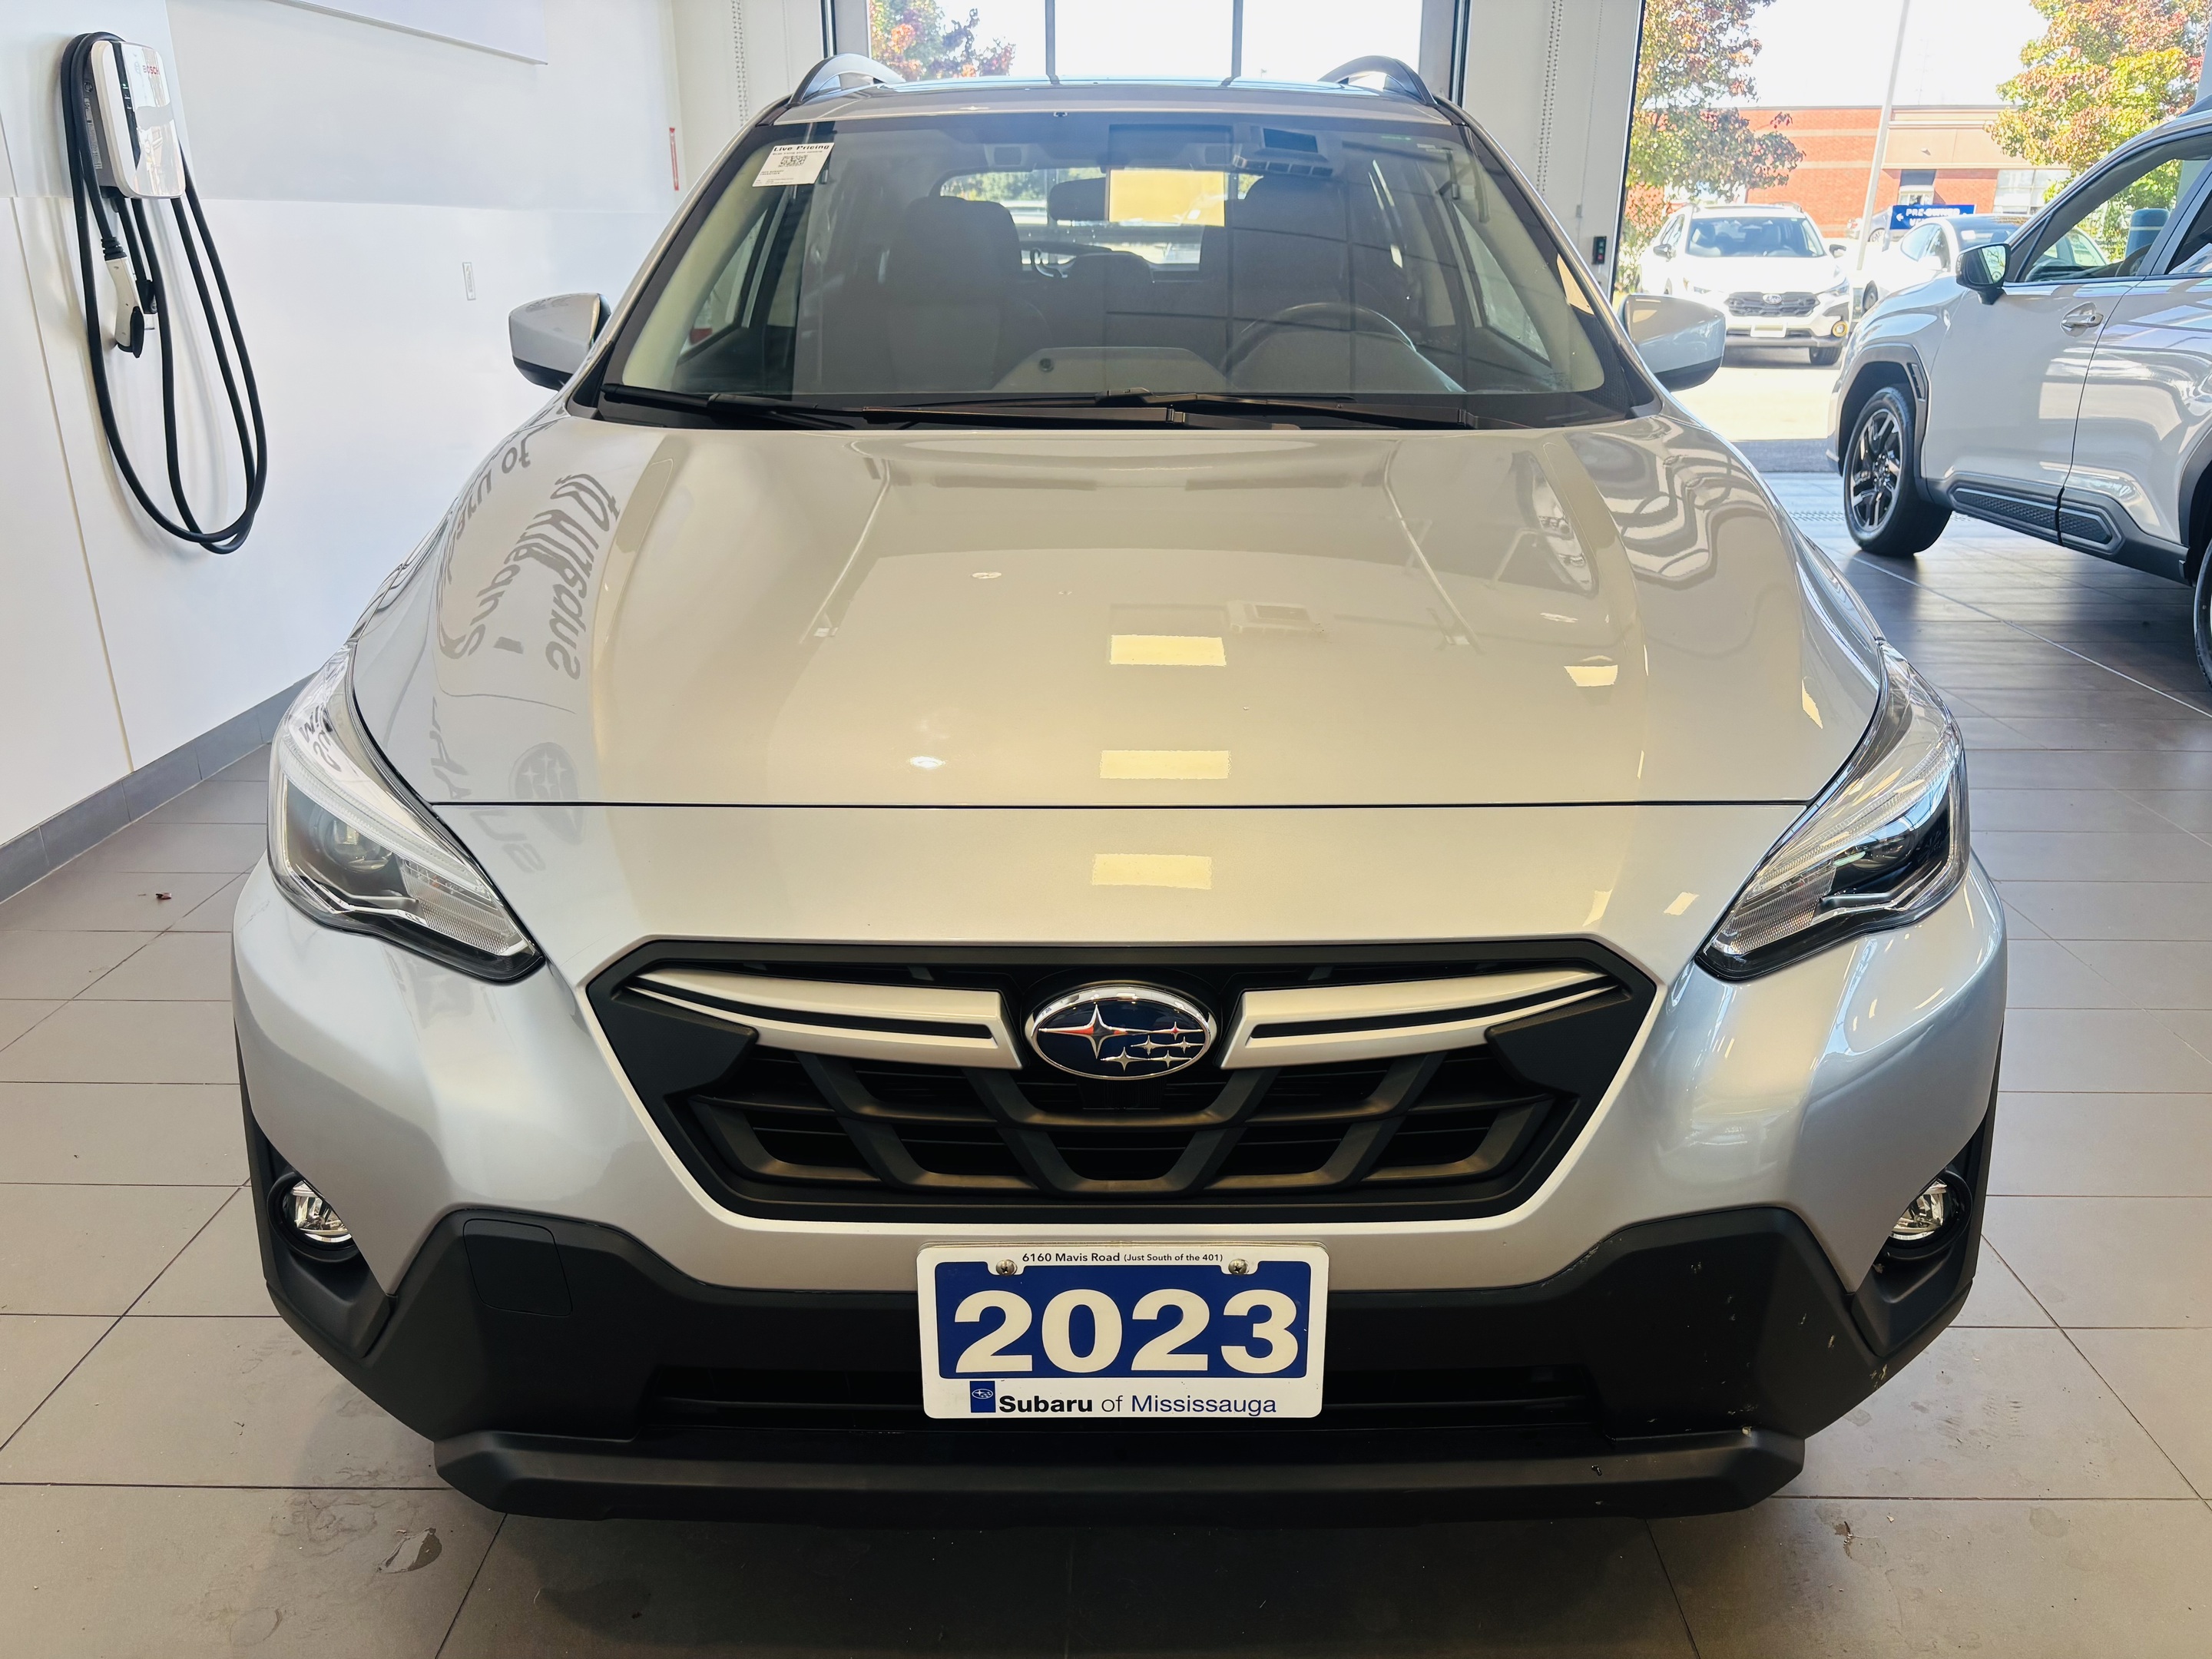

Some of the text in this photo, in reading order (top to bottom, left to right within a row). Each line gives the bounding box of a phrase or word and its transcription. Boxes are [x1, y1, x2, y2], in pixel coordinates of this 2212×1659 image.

[1022, 1253, 1052, 1262] 6160
[1055, 1253, 1088, 1262] Mavis
[1091, 1253, 1120, 1262] Road
[1124, 1253, 1144, 1262] (Just
[1202, 1253, 1224, 1262] 401)
[954, 1289, 1298, 1373] 2023
[998, 1395, 1277, 1417] Subaru of Mississauga
